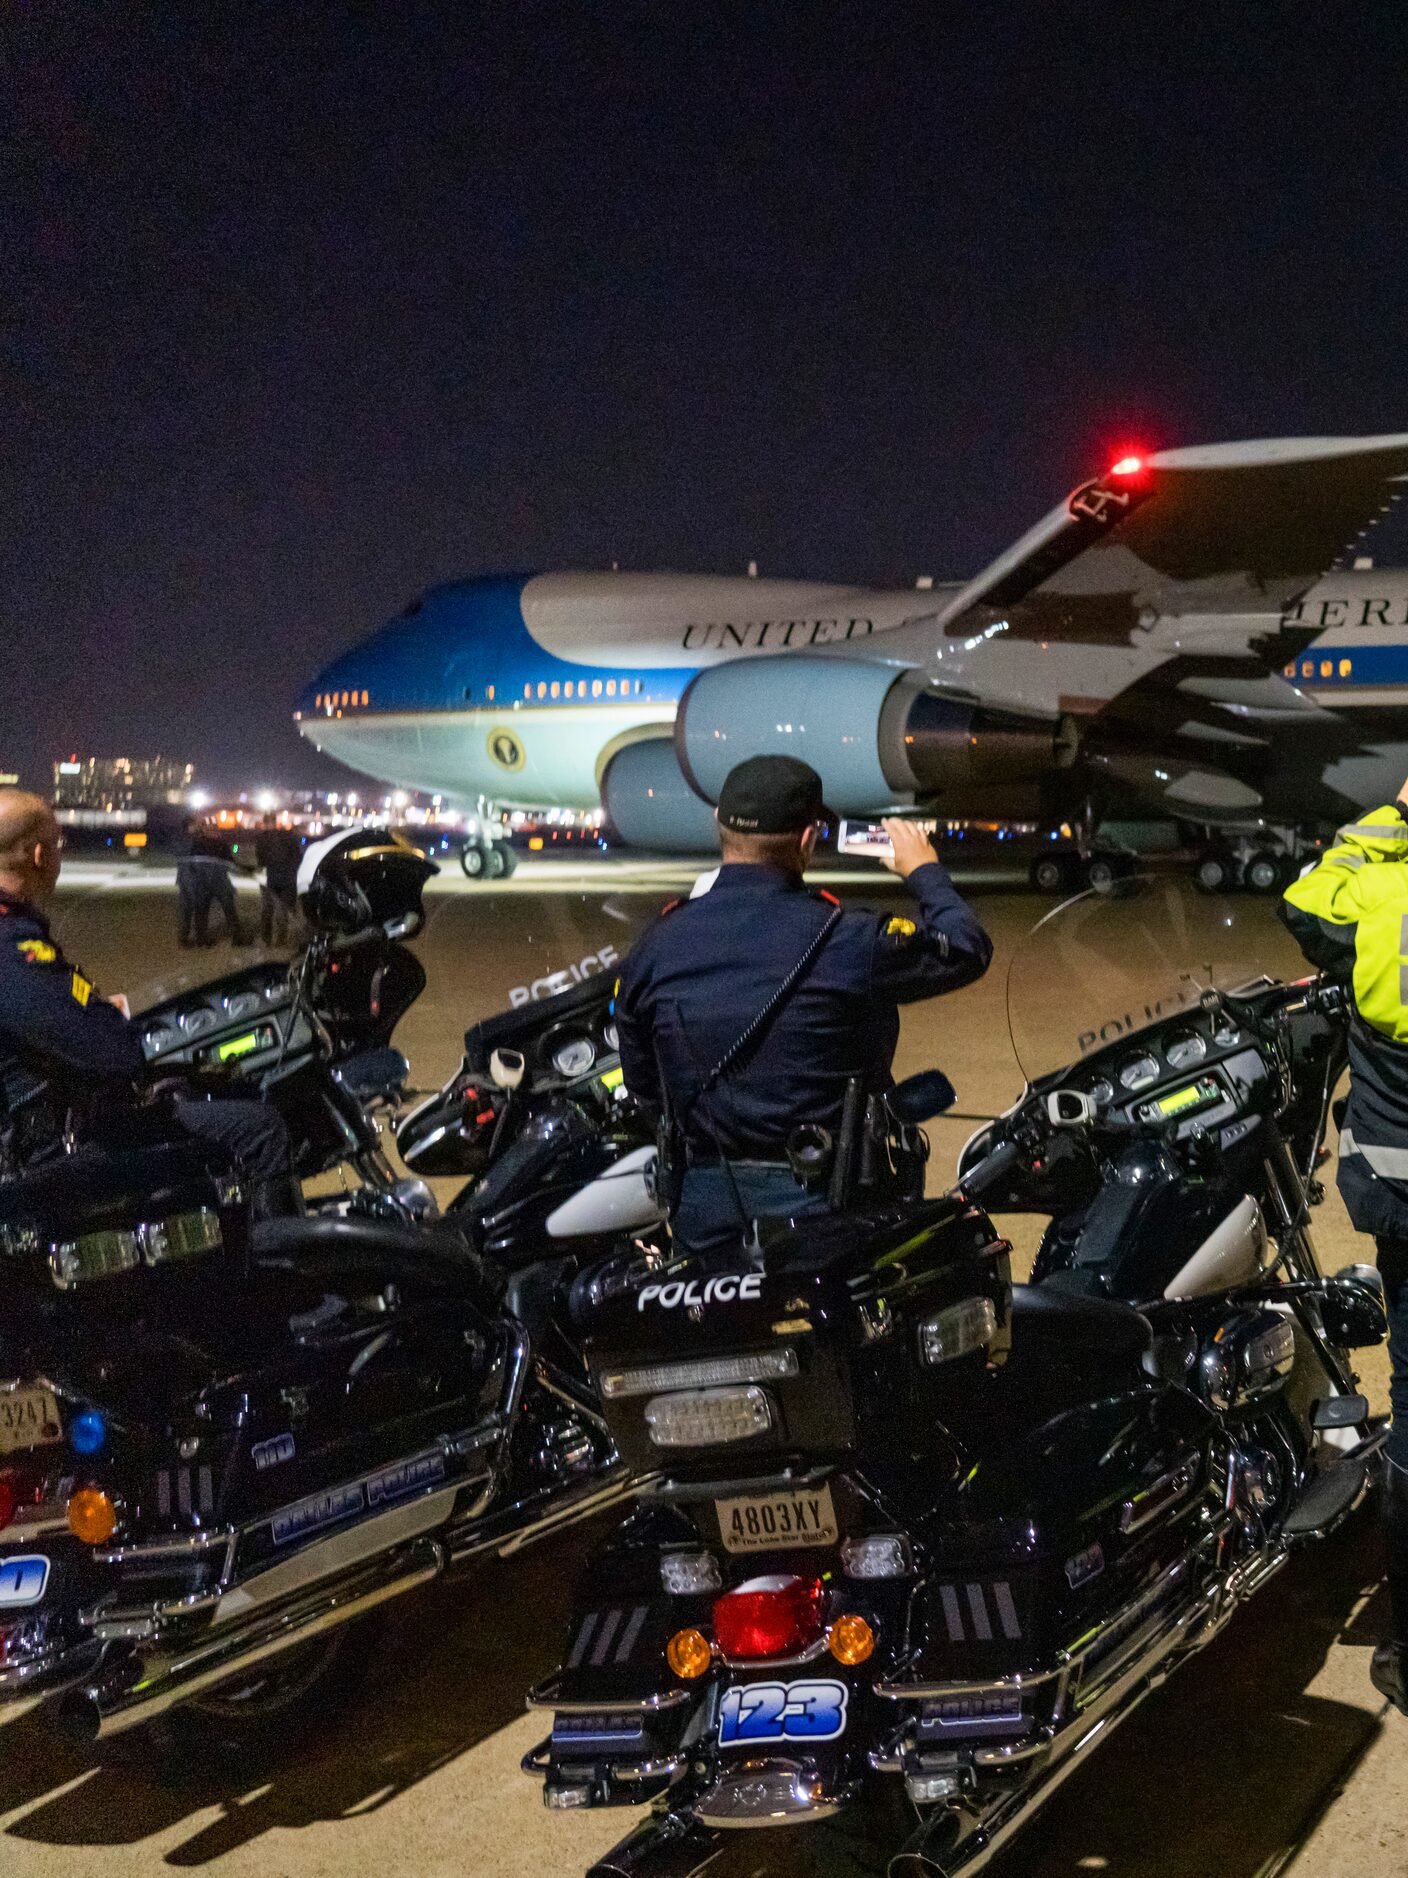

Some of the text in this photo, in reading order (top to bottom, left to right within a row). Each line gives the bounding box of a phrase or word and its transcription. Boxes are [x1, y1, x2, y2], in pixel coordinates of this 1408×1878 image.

[682, 617, 875, 649] UNITED
[638, 1273, 767, 1313] POLICE
[732, 1500, 820, 1536] 4803XY
[719, 1679, 848, 1747] 123
